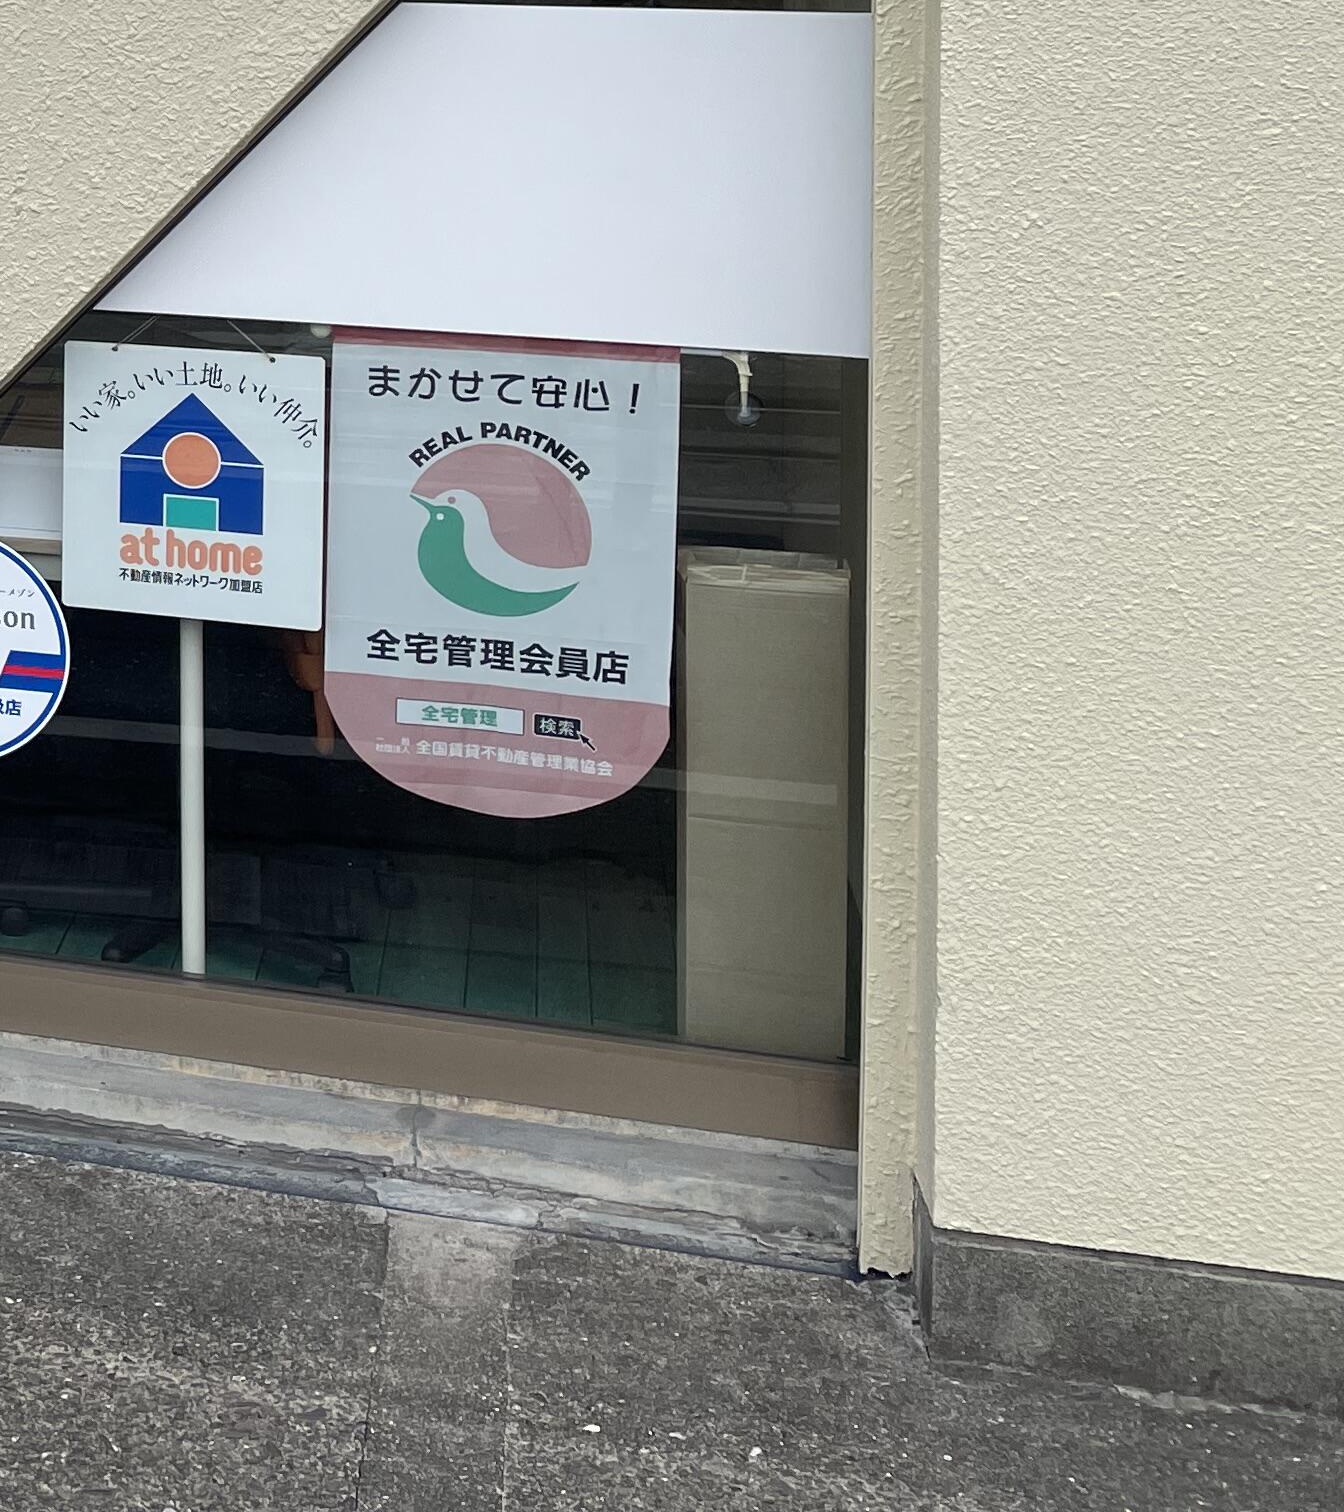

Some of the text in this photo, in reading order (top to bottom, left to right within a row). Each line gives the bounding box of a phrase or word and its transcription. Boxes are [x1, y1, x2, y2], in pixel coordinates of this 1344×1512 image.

[409, 421, 591, 481] REAL PARTNER
[120, 528, 263, 576] at home
[119, 567, 263, 594] 不動産情報ネットワーク加盟店
[366, 629, 630, 685] 全宅管理会員店
[421, 705, 499, 728] 全宅管理
[539, 717, 576, 737] 検索
[416, 740, 614, 777] 全国賃貸不動産管理業協会
